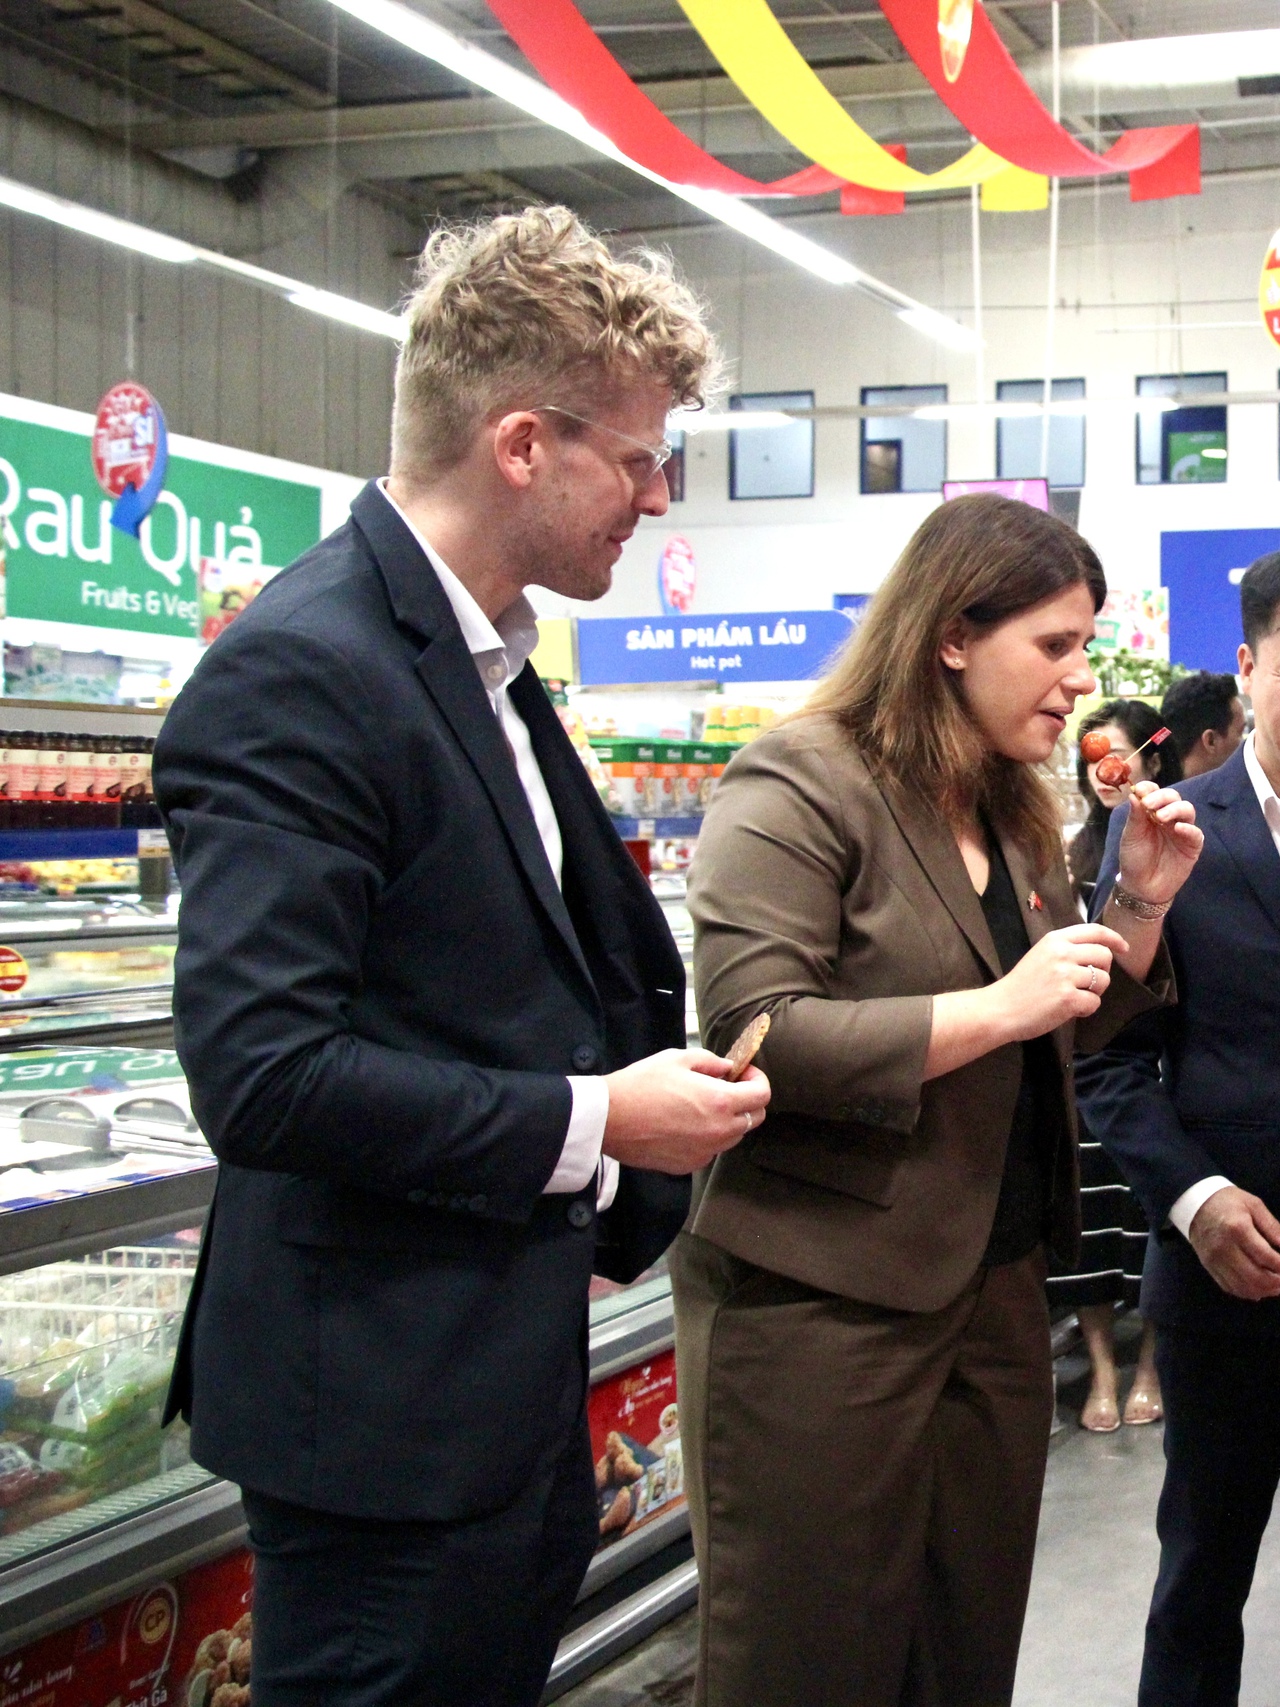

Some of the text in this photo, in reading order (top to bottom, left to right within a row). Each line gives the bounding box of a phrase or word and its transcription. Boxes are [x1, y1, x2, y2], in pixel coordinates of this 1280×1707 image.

[81, 581, 141, 612] Fruits
[145, 590, 161, 615] &
[626, 617, 807, 651] SẢN PHẨM LẨU
[690, 653, 742, 672] Hot pot
[146, 1609, 165, 1632] CP
